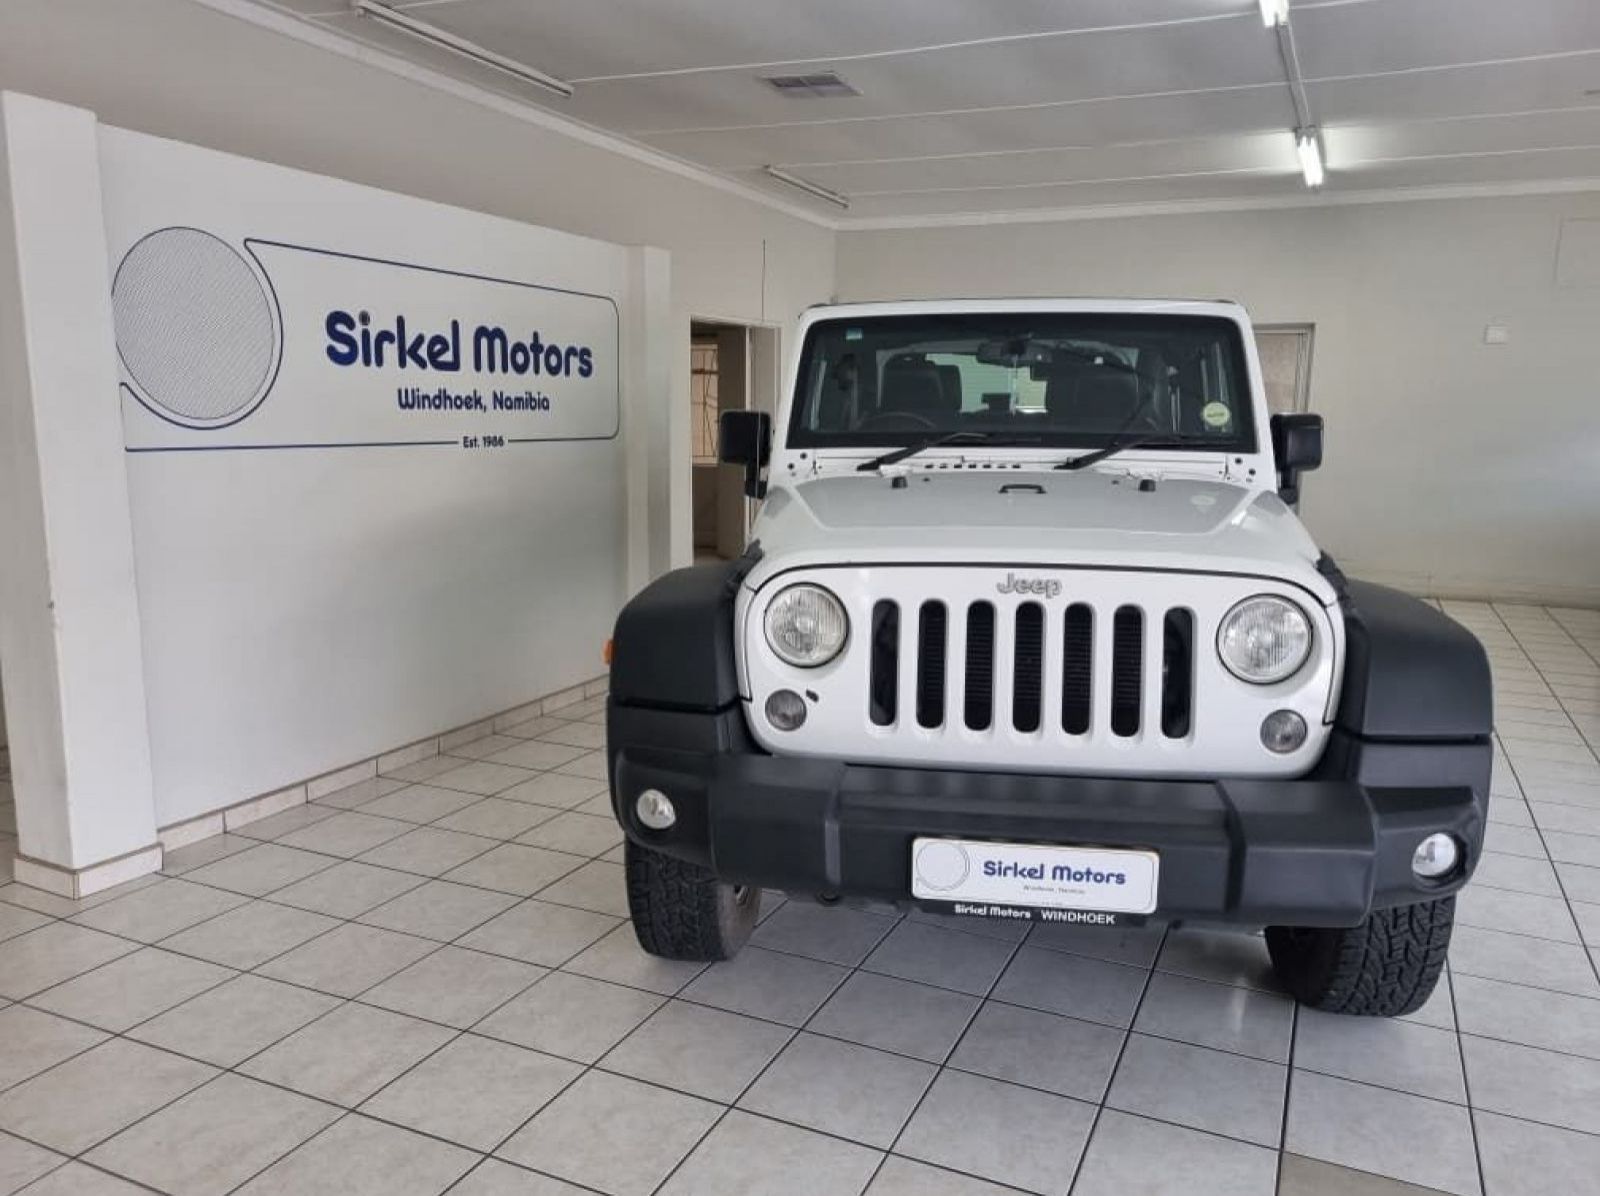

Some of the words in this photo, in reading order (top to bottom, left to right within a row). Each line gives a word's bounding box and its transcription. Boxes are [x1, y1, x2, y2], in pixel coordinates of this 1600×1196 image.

[326, 310, 461, 372] Sirkel
[473, 325, 593, 378] Motors
[398, 387, 487, 413] Windhoek,
[492, 390, 550, 411] Namibia
[996, 572, 1062, 599] Jeep
[983, 860, 1045, 880] Sirkel
[1051, 865, 1126, 885] Motors
[954, 903, 987, 915] Sirkel
[990, 906, 1031, 919] Motors
[1040, 909, 1116, 925] WINDHOEK
